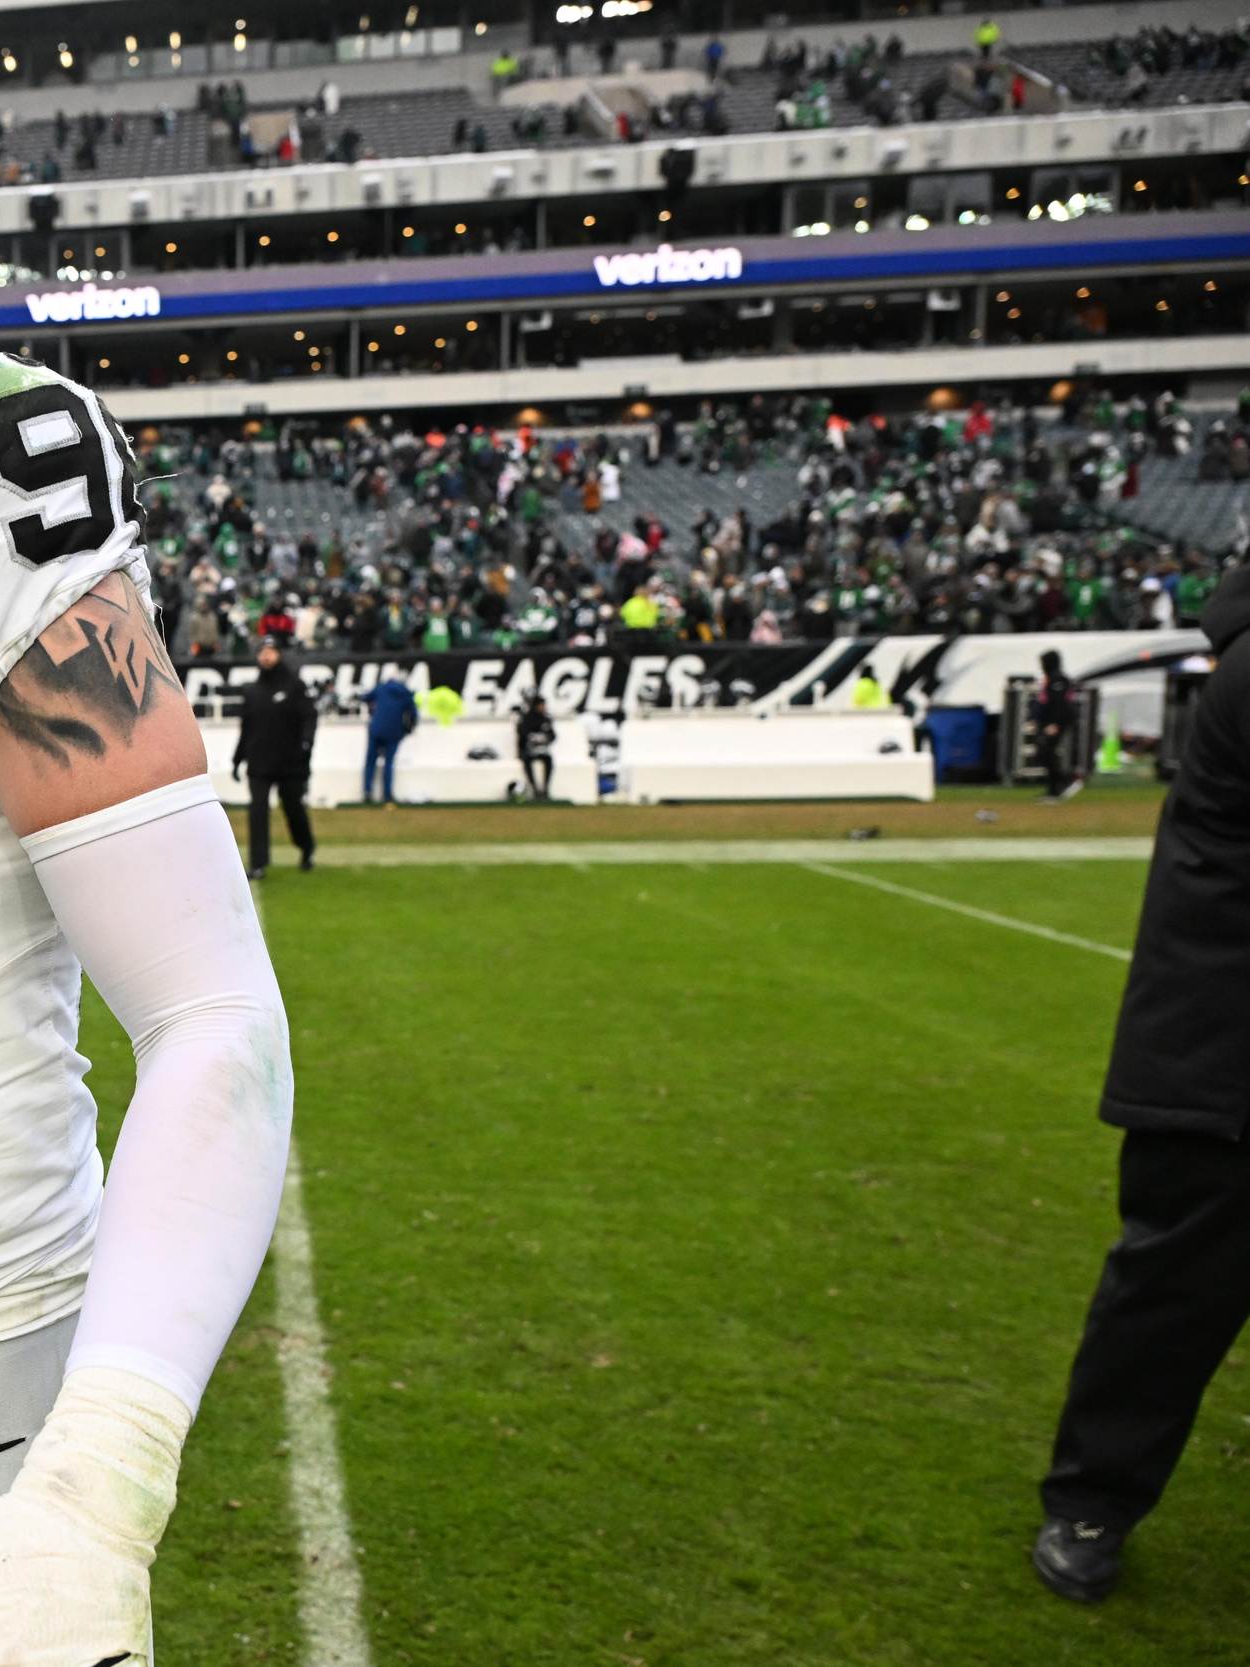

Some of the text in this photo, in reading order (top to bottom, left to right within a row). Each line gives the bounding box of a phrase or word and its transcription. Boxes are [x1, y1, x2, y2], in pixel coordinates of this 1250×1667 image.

[593, 243, 742, 286] verizon
[25, 283, 161, 323] verizon
[461, 655, 706, 716] EAGLES
